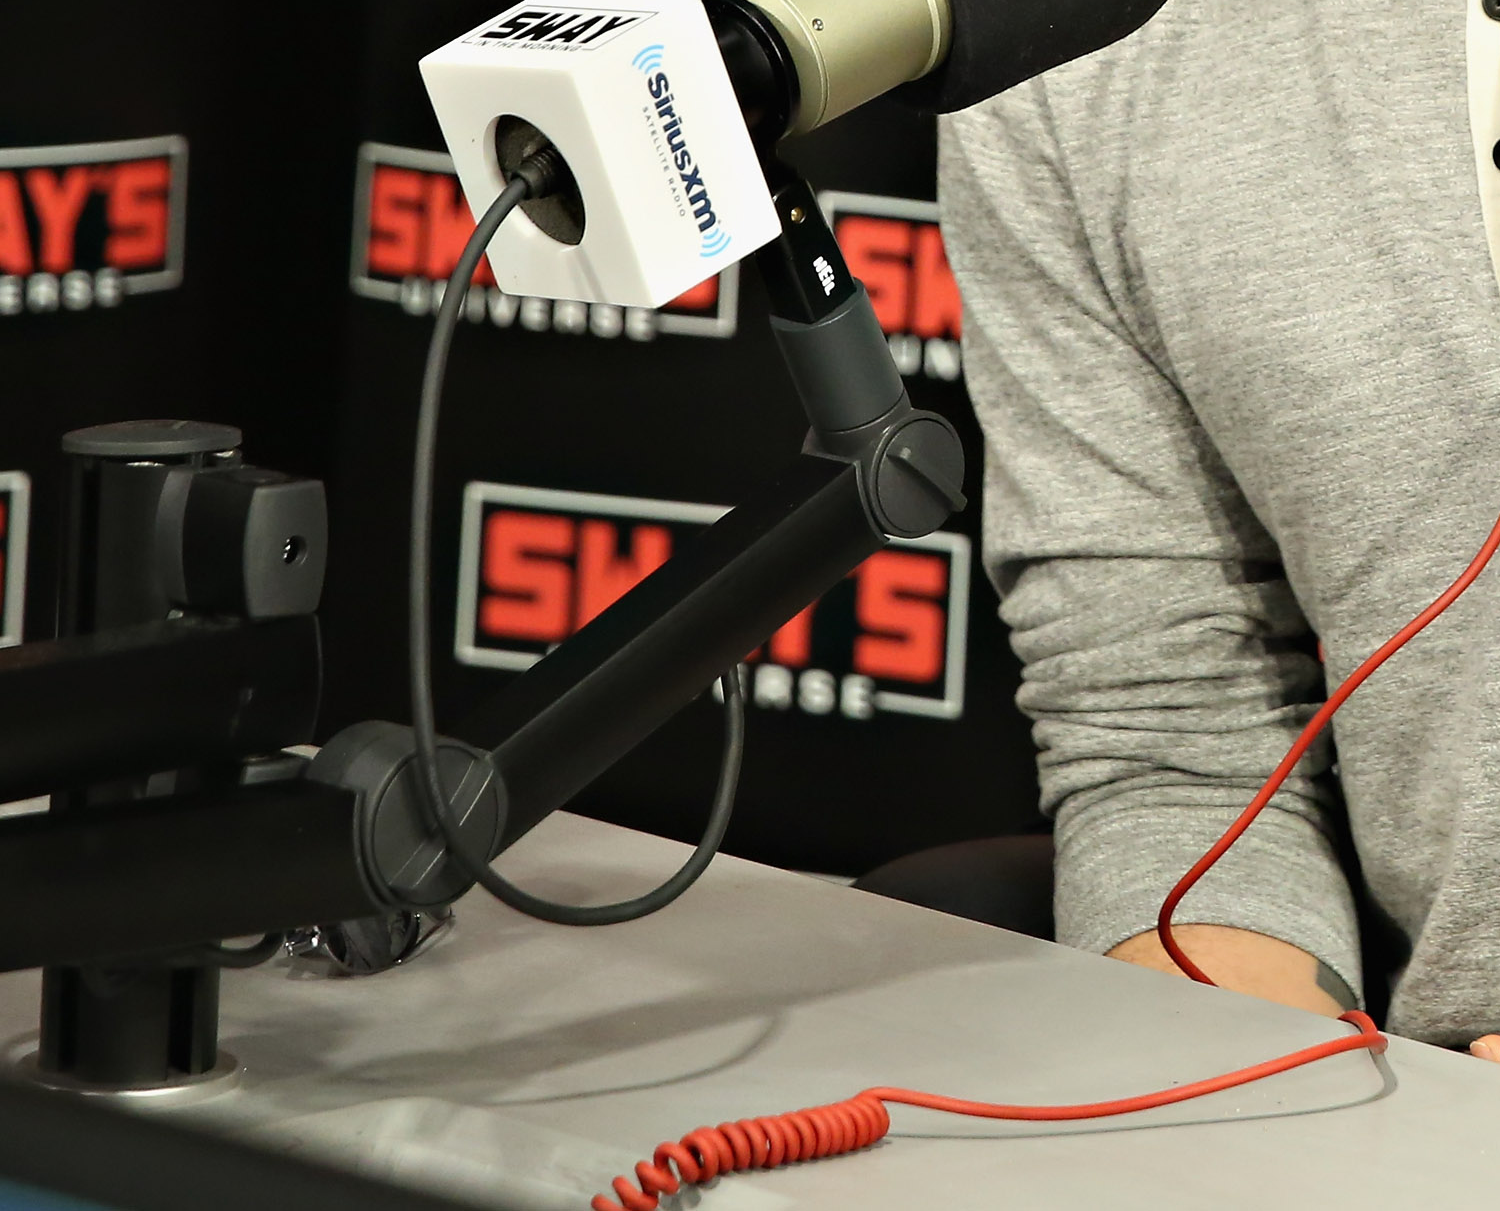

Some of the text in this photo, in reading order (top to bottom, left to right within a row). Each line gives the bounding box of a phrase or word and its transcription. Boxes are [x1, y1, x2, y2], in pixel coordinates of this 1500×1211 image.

[480, 11, 640, 44] SWAY
[493, 41, 518, 49] THE
[521, 43, 582, 52] MORNING
[642, 106, 686, 218] SATELLITE RADIO
